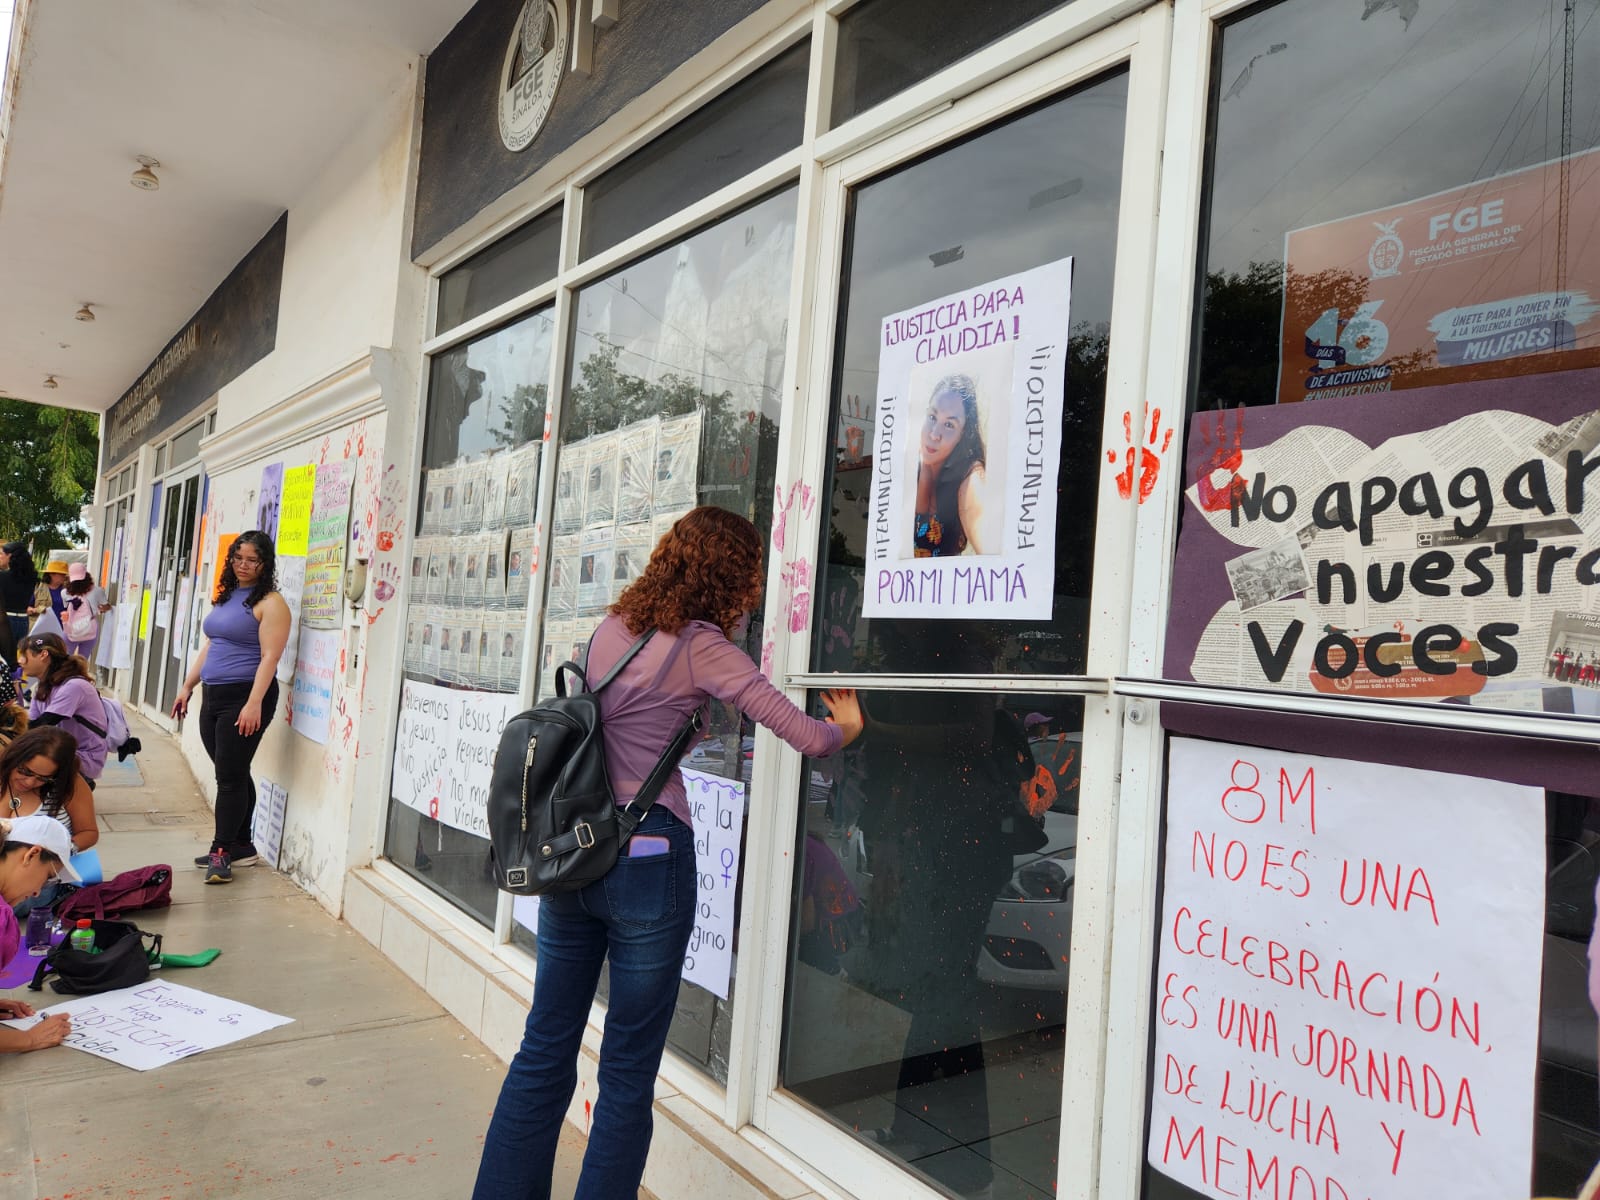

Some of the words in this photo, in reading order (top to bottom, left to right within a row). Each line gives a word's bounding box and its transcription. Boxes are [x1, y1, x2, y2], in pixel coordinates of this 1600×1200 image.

[512, 60, 545, 114] FGE
[547, 38, 565, 99] ESTADO
[511, 90, 543, 124] SINALOA
[1408, 240, 1452, 258] FISCALÍA
[1454, 230, 1501, 246] GENERAL
[1503, 224, 1524, 236] DEL
[1429, 199, 1504, 241] FGE
[1414, 250, 1453, 266] ESTADO
[1455, 246, 1470, 256] DE
[1470, 235, 1516, 252] SINALOA
[885, 299, 968, 347] ¡JUSTICIA
[972, 286, 1025, 318] PARA
[1459, 325, 1469, 336] LA
[1471, 317, 1513, 335] VIOLENCIA
[1514, 312, 1548, 327] CONTRA
[1485, 306, 1513, 321] PARA
[1515, 299, 1551, 316] PONER
[1553, 296, 1573, 309] FIN
[1305, 299, 1389, 370] 16
[1462, 327, 1552, 361] MUJERES
[1310, 376, 1325, 390] DE
[1326, 365, 1386, 386] ACTIVISMO
[1231, 472, 1297, 528] No
[878, 569, 915, 604] POR
[919, 568, 943, 605] MI
[952, 563, 1027, 605] MAMÁ
[716, 789, 733, 831] la
[1221, 759, 1316, 835] 8M
[1192, 830, 1248, 881] NO
[1260, 844, 1311, 897] ES
[1339, 858, 1439, 926] UNA
[1161, 973, 1199, 1029] ES
[1217, 997, 1280, 1058] UNA
[1293, 1024, 1482, 1136] JORNADA
[1164, 1054, 1203, 1104] DE
[1220, 1070, 1340, 1154] LUCHA
[1380, 1121, 1405, 1175] Y
